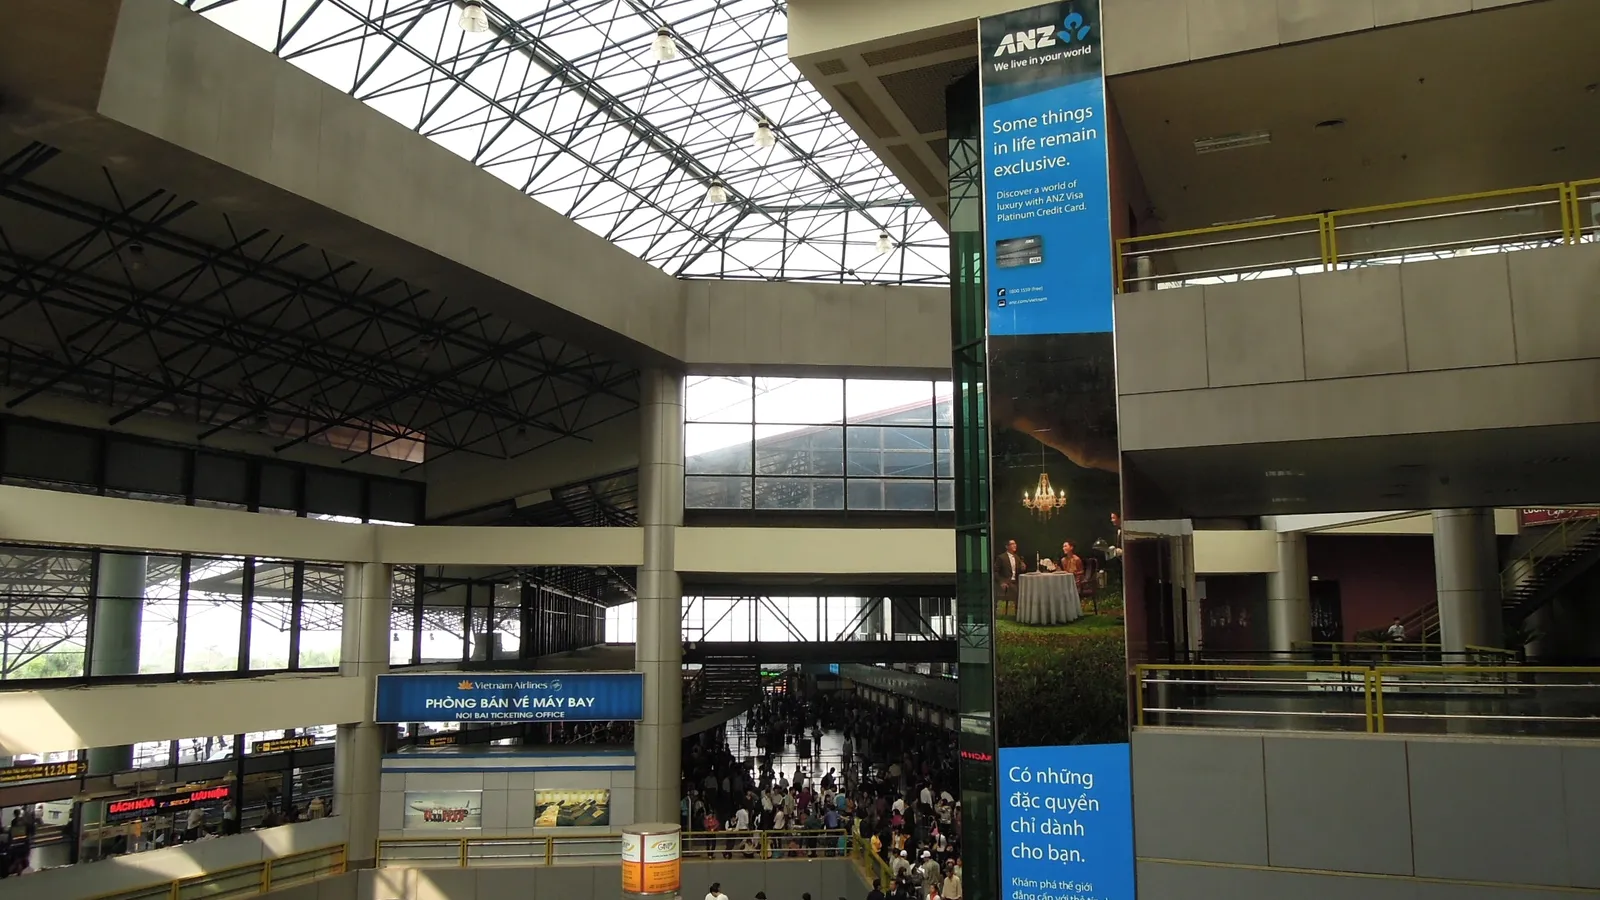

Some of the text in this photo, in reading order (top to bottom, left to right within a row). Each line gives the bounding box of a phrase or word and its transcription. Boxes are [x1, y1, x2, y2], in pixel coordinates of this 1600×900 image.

[993, 24, 1056, 57] ANZ
[994, 45, 1091, 71] We live in your world
[993, 106, 1093, 134] Some things
[993, 127, 1097, 155] in life remain
[993, 155, 1070, 177] exclusive.
[996, 186, 1033, 200] Discover
[1042, 181, 1066, 193] world
[1067, 179, 1077, 189] of
[996, 191, 1084, 212] luxury with ANZ Visa
[997, 202, 1087, 223] Platinum Credit Card.
[474, 681, 548, 690] Vietnam Airlines
[425, 694, 595, 709] PHÒNG BÁN VÉ MÁY BAY
[490, 711, 534, 719] TICKETING
[1008, 766, 1094, 790] Có những
[109, 797, 156, 814] BÁCH HÓA
[1009, 791, 1100, 815] đặc quyền
[1010, 817, 1085, 837] chỉ dành
[1011, 842, 1086, 865] cho bạn.
[1011, 877, 1093, 893] Khám phá thế giới
